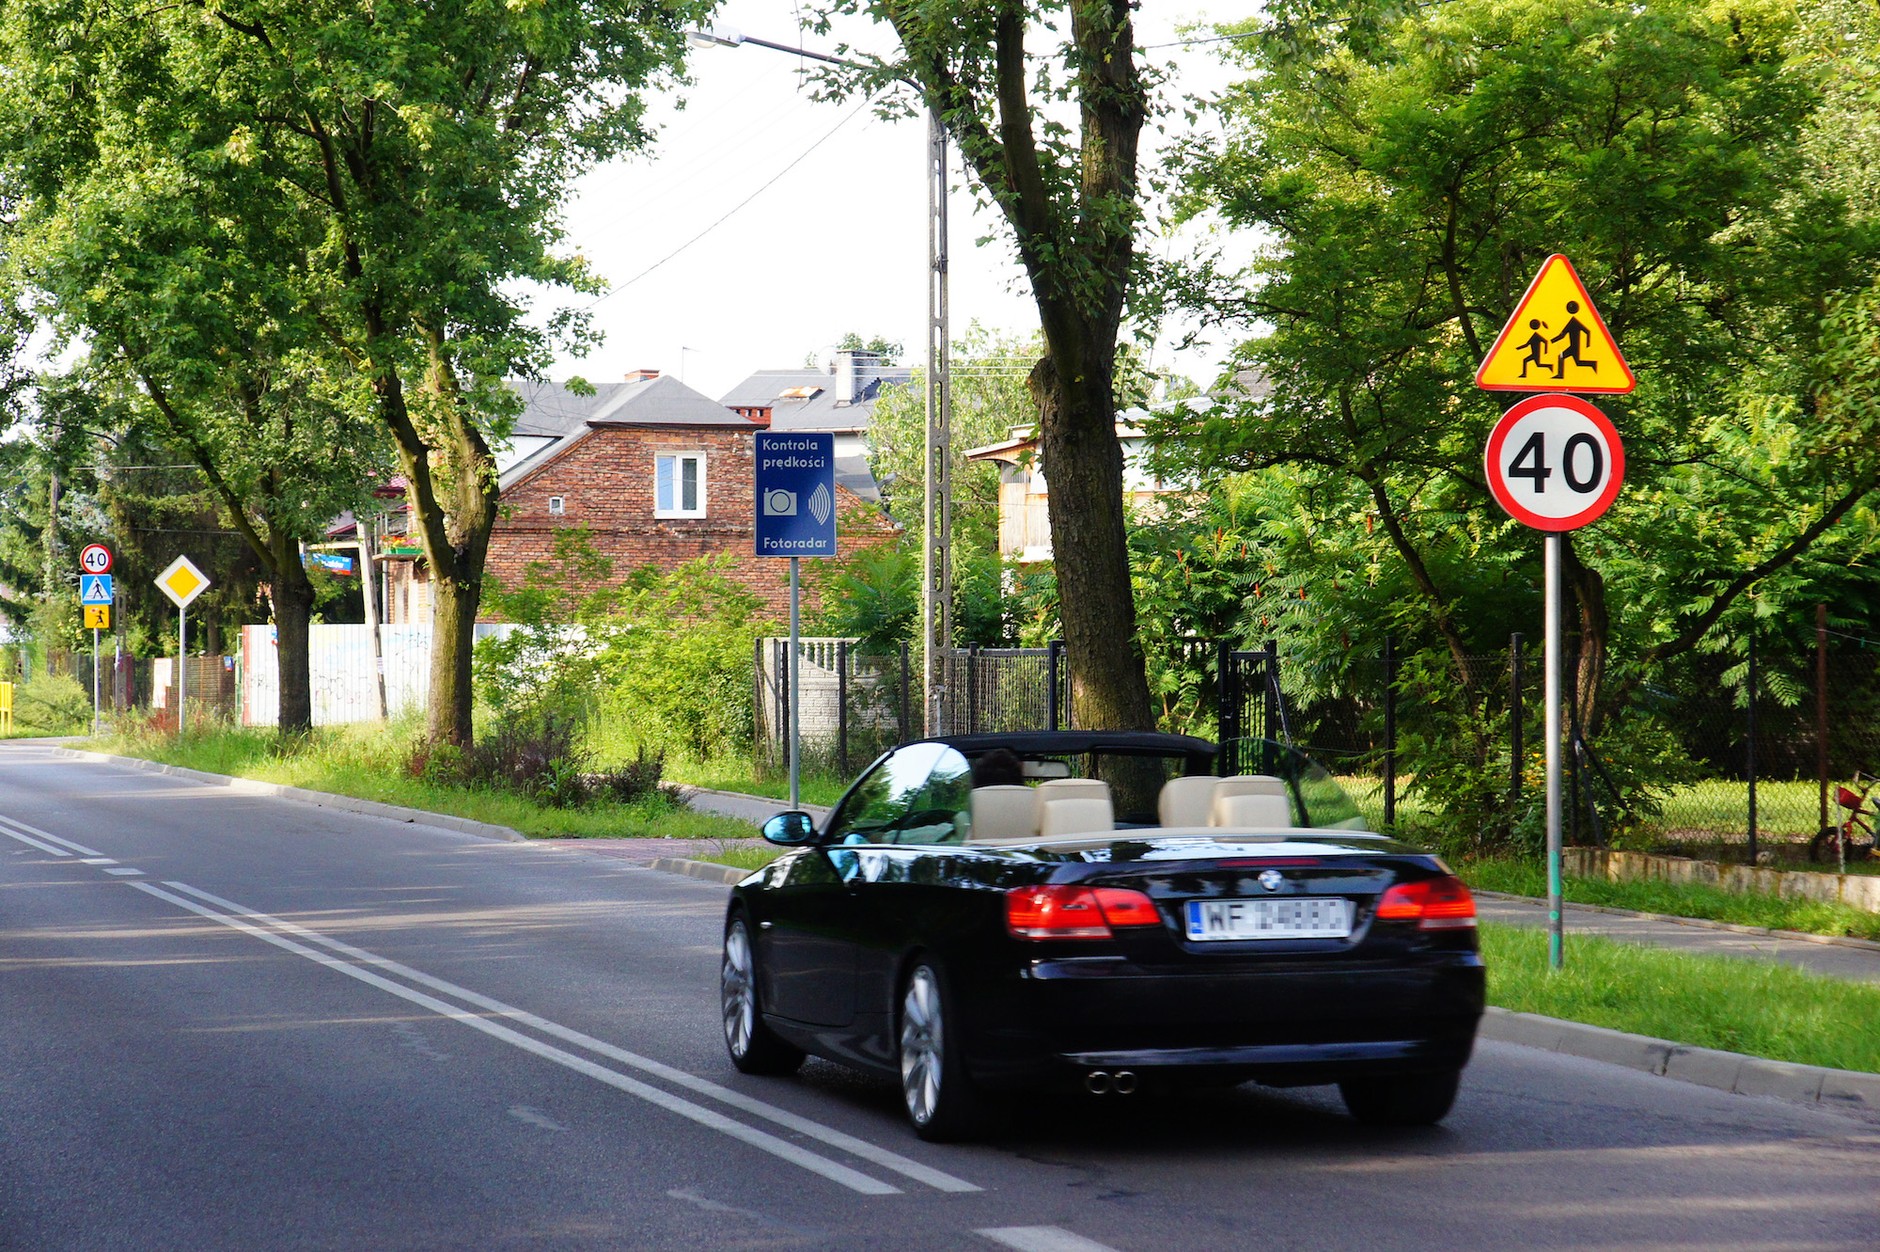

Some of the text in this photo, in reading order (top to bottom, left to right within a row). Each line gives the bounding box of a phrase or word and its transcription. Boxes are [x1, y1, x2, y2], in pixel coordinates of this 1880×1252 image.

[762, 438, 819, 451] Kontrola
[763, 455, 825, 471] prędkości
[1508, 431, 1604, 494] 40
[763, 536, 827, 549] Fotoradar
[85, 552, 107, 567] 40
